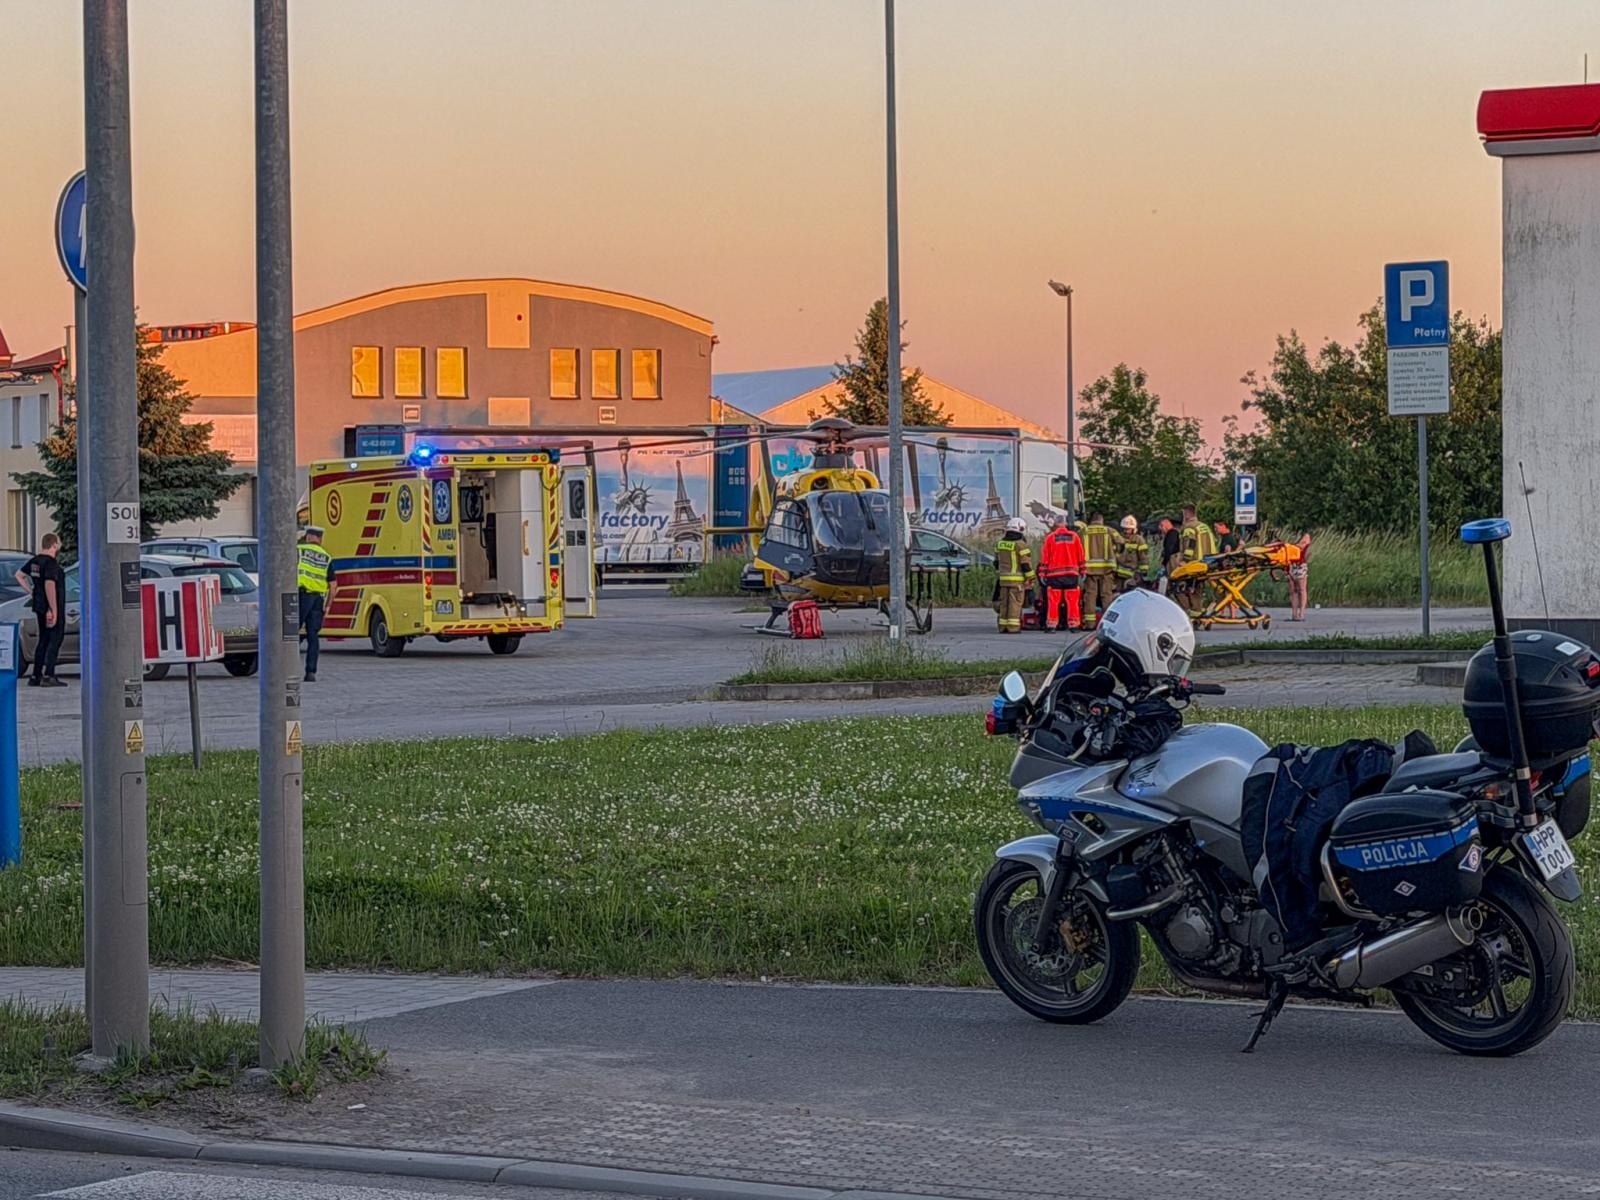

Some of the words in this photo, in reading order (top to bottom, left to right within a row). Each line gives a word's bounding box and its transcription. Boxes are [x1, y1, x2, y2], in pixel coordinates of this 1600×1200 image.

[1400, 270, 1434, 321] P
[1414, 328, 1446, 338] Płatny
[1241, 478, 1252, 503] P
[329, 490, 338, 520] S
[922, 508, 982, 526] factory
[601, 512, 669, 530] factory
[158, 590, 183, 651] H
[1533, 826, 1555, 852] HPP
[1361, 841, 1429, 865] POLICJA
[1540, 844, 1572, 874] T001
